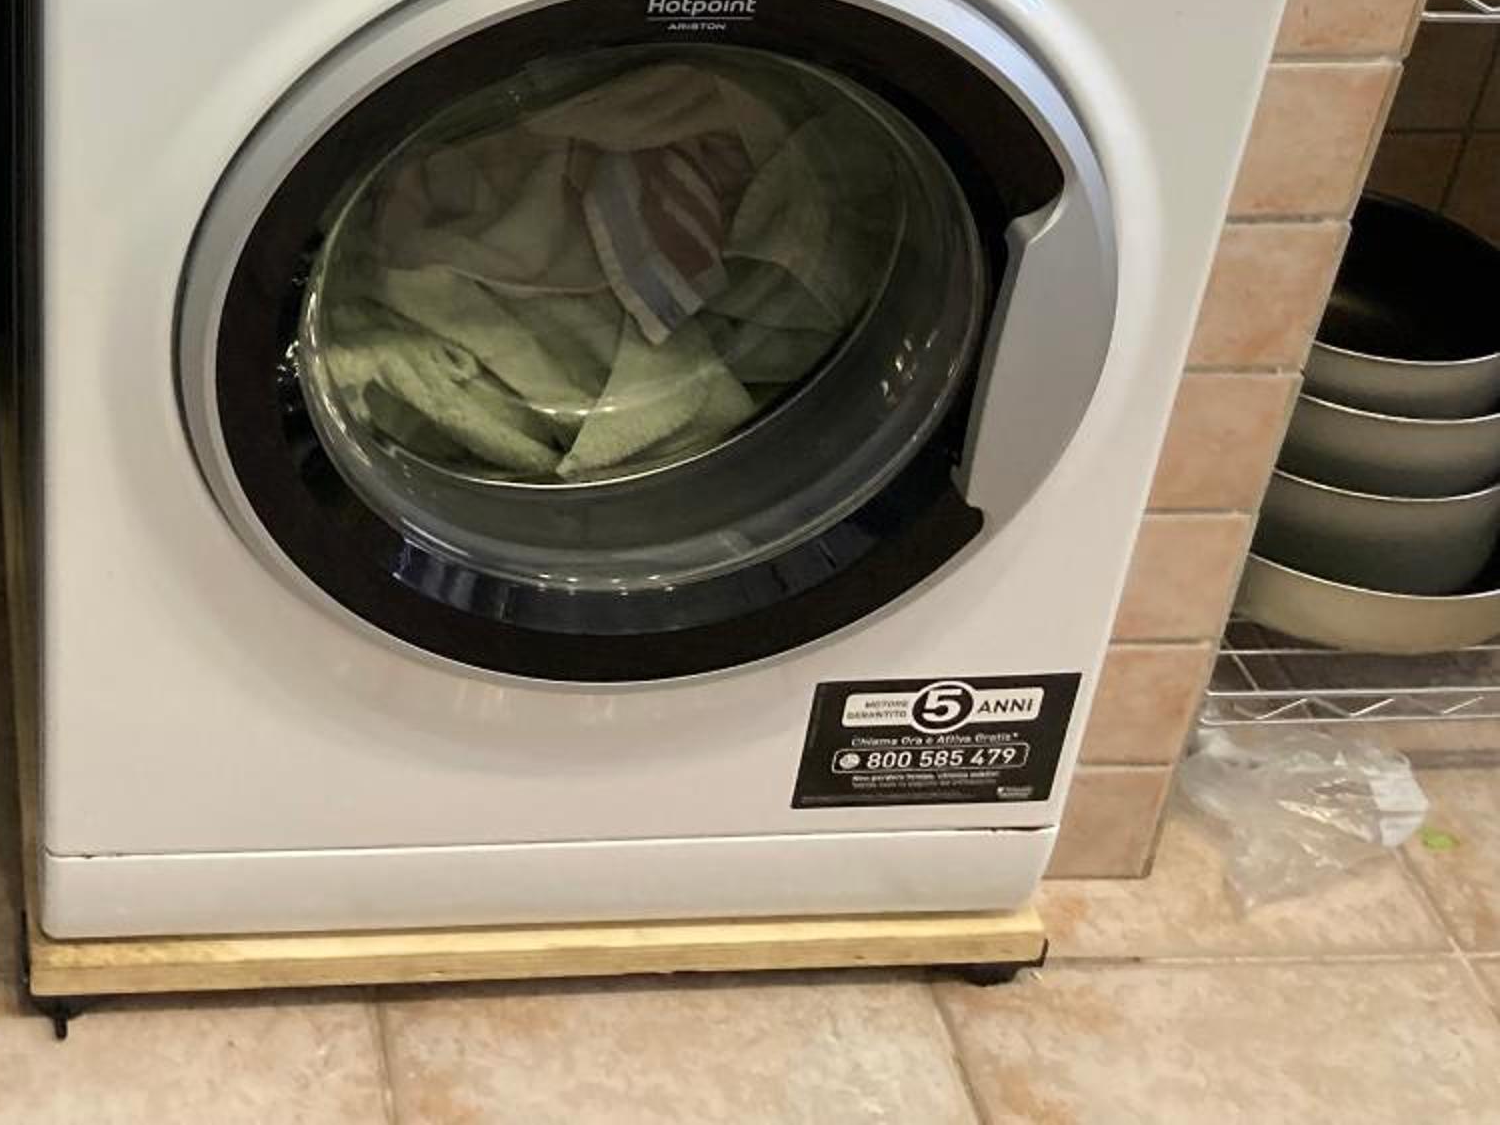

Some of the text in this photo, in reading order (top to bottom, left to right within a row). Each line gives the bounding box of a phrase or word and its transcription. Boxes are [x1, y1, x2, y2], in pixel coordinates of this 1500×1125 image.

[668, 22, 727, 31] ARISTON
[921, 687, 963, 722] 5
[977, 698, 1034, 714] ANNI
[852, 735, 898, 748] Chiama
[902, 735, 923, 746] Ora
[937, 733, 972, 745] Attiva
[867, 747, 1016, 769] 800 585 479
